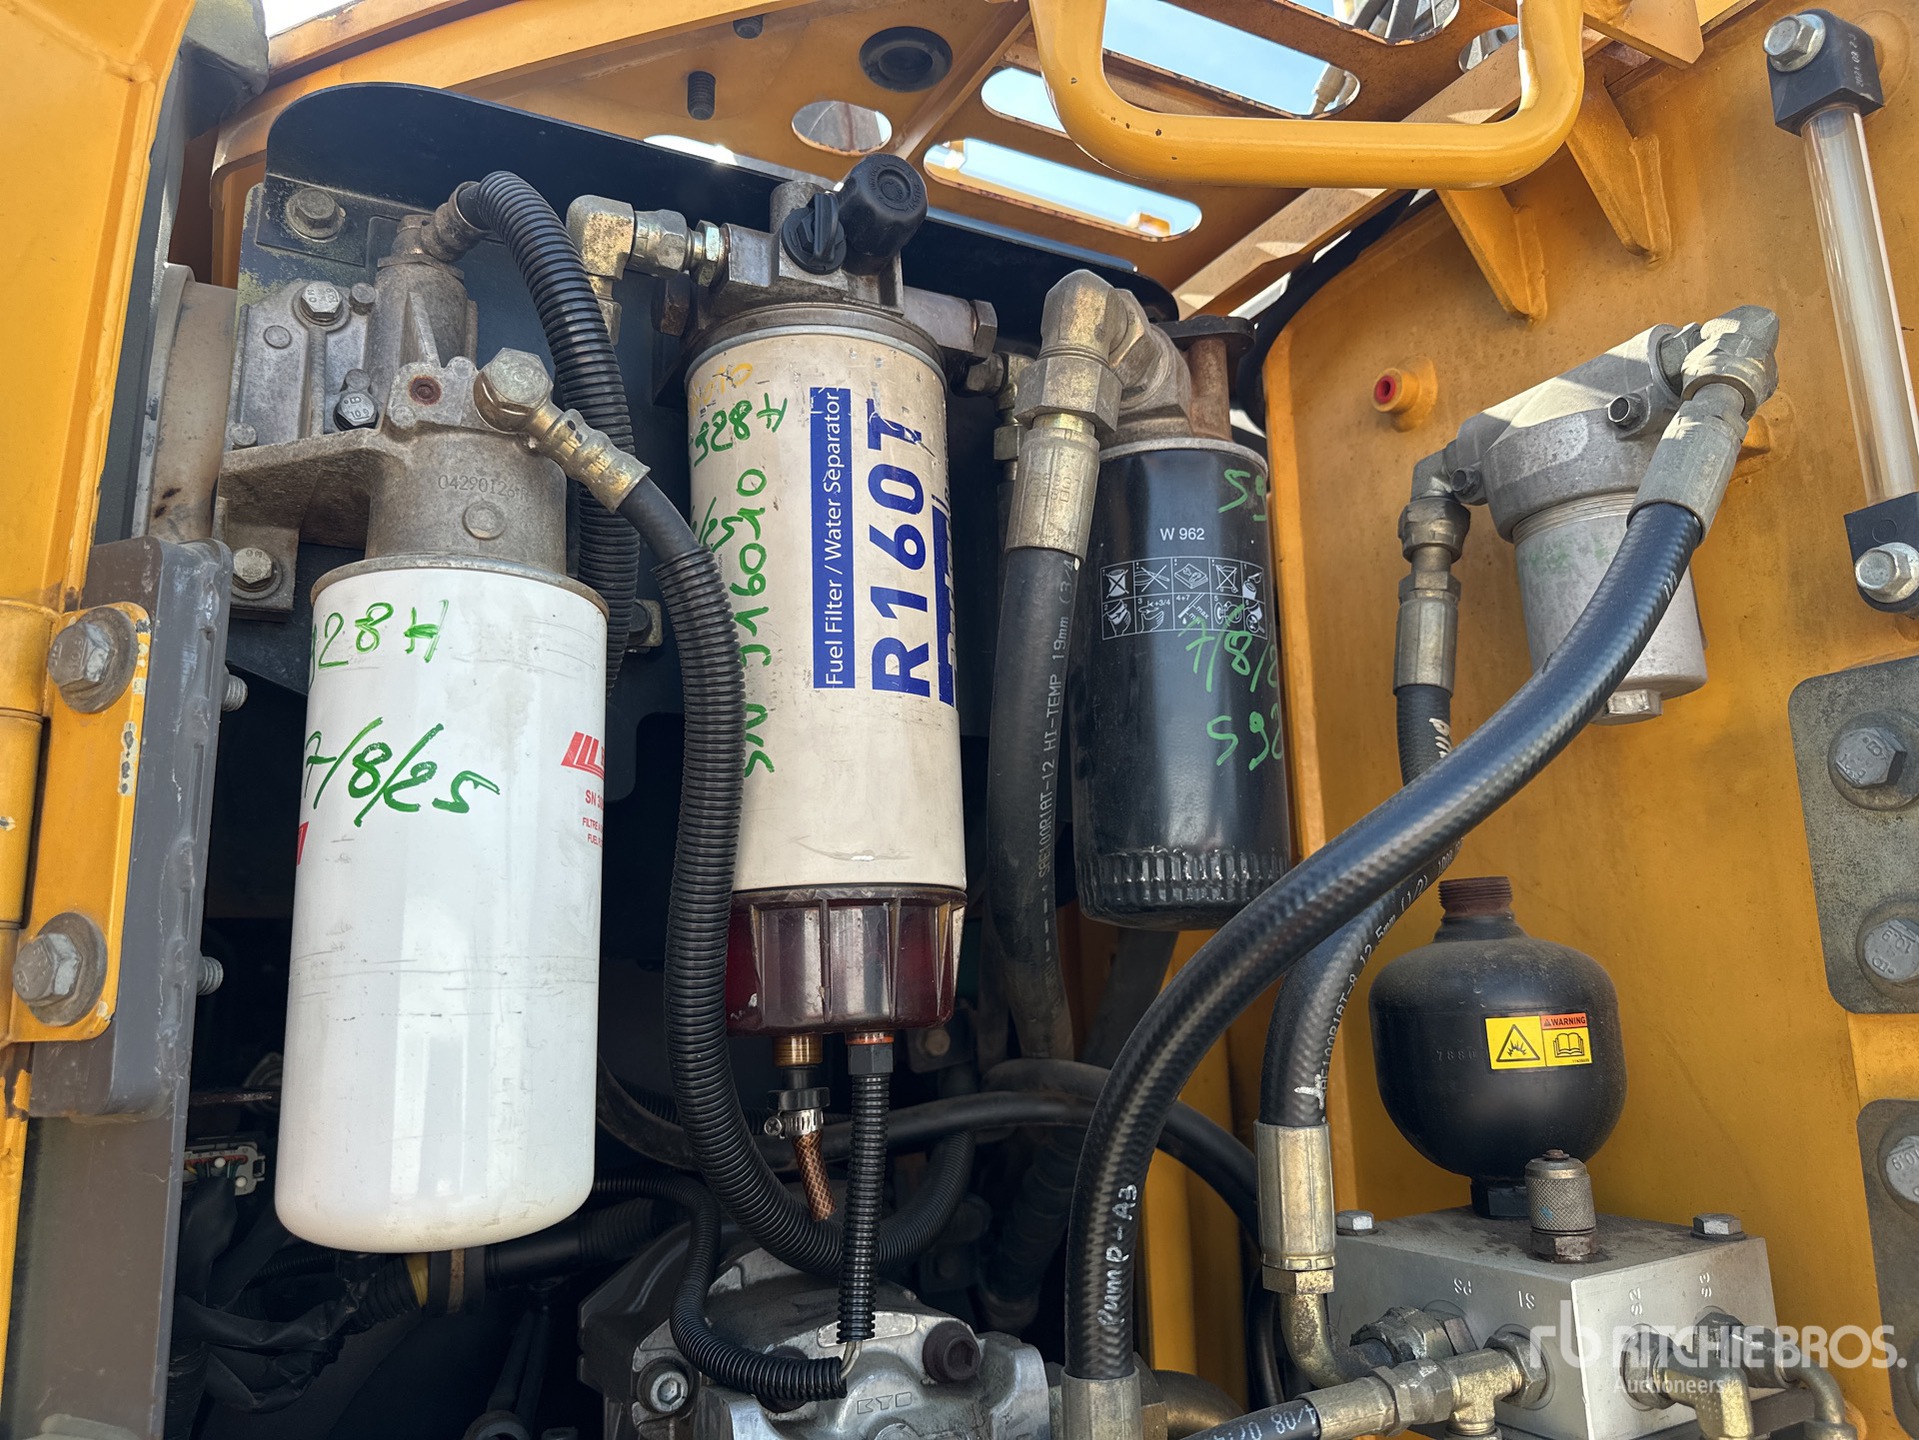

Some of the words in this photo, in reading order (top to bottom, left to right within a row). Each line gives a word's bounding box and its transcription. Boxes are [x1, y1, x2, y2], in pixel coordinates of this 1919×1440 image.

[823, 391, 845, 494] Separator
[824, 498, 842, 561] Water
[865, 398, 931, 698] R160T
[1160, 527, 1175, 541] W
[1179, 527, 1206, 541] 962
[824, 564, 843, 575] /
[824, 579, 843, 633] Filter
[1052, 616, 1069, 660] 19mm
[825, 640, 844, 685] Fuel
[1043, 673, 1062, 752] HI-TEMP
[1550, 1016, 1586, 1027] WARNING
[856, 1391, 913, 1415] KYB
